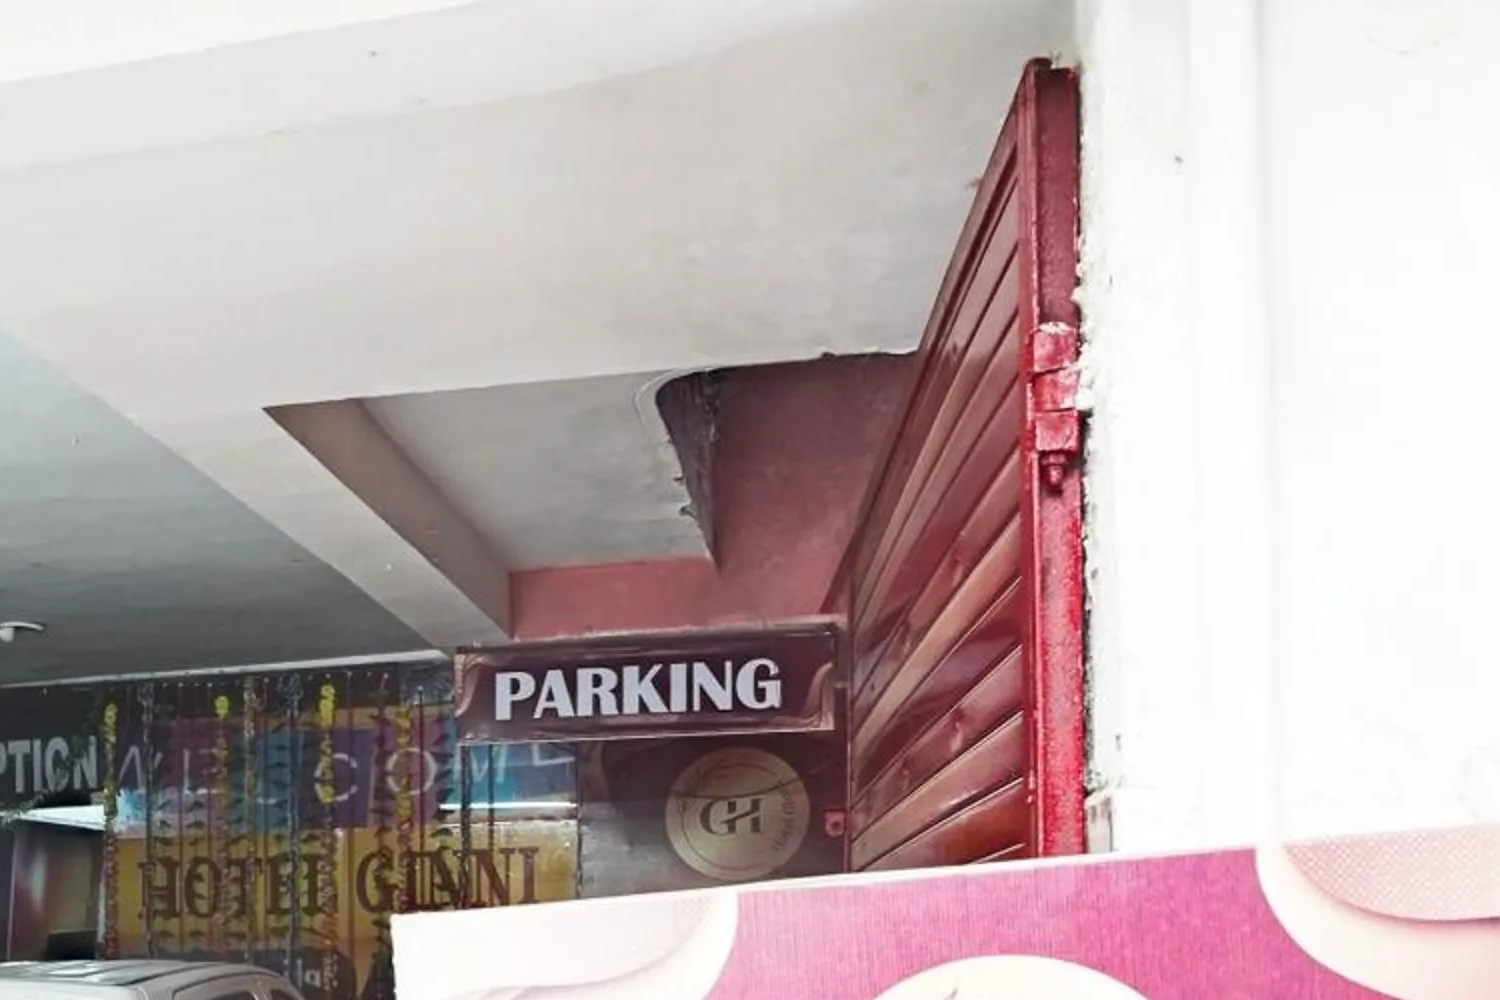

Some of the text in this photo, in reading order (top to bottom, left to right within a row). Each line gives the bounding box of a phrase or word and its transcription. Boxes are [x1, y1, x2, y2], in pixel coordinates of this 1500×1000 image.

[495, 657, 783, 721] PARKING
[699, 797, 762, 834] GH
[137, 851, 338, 921] HOTEL
